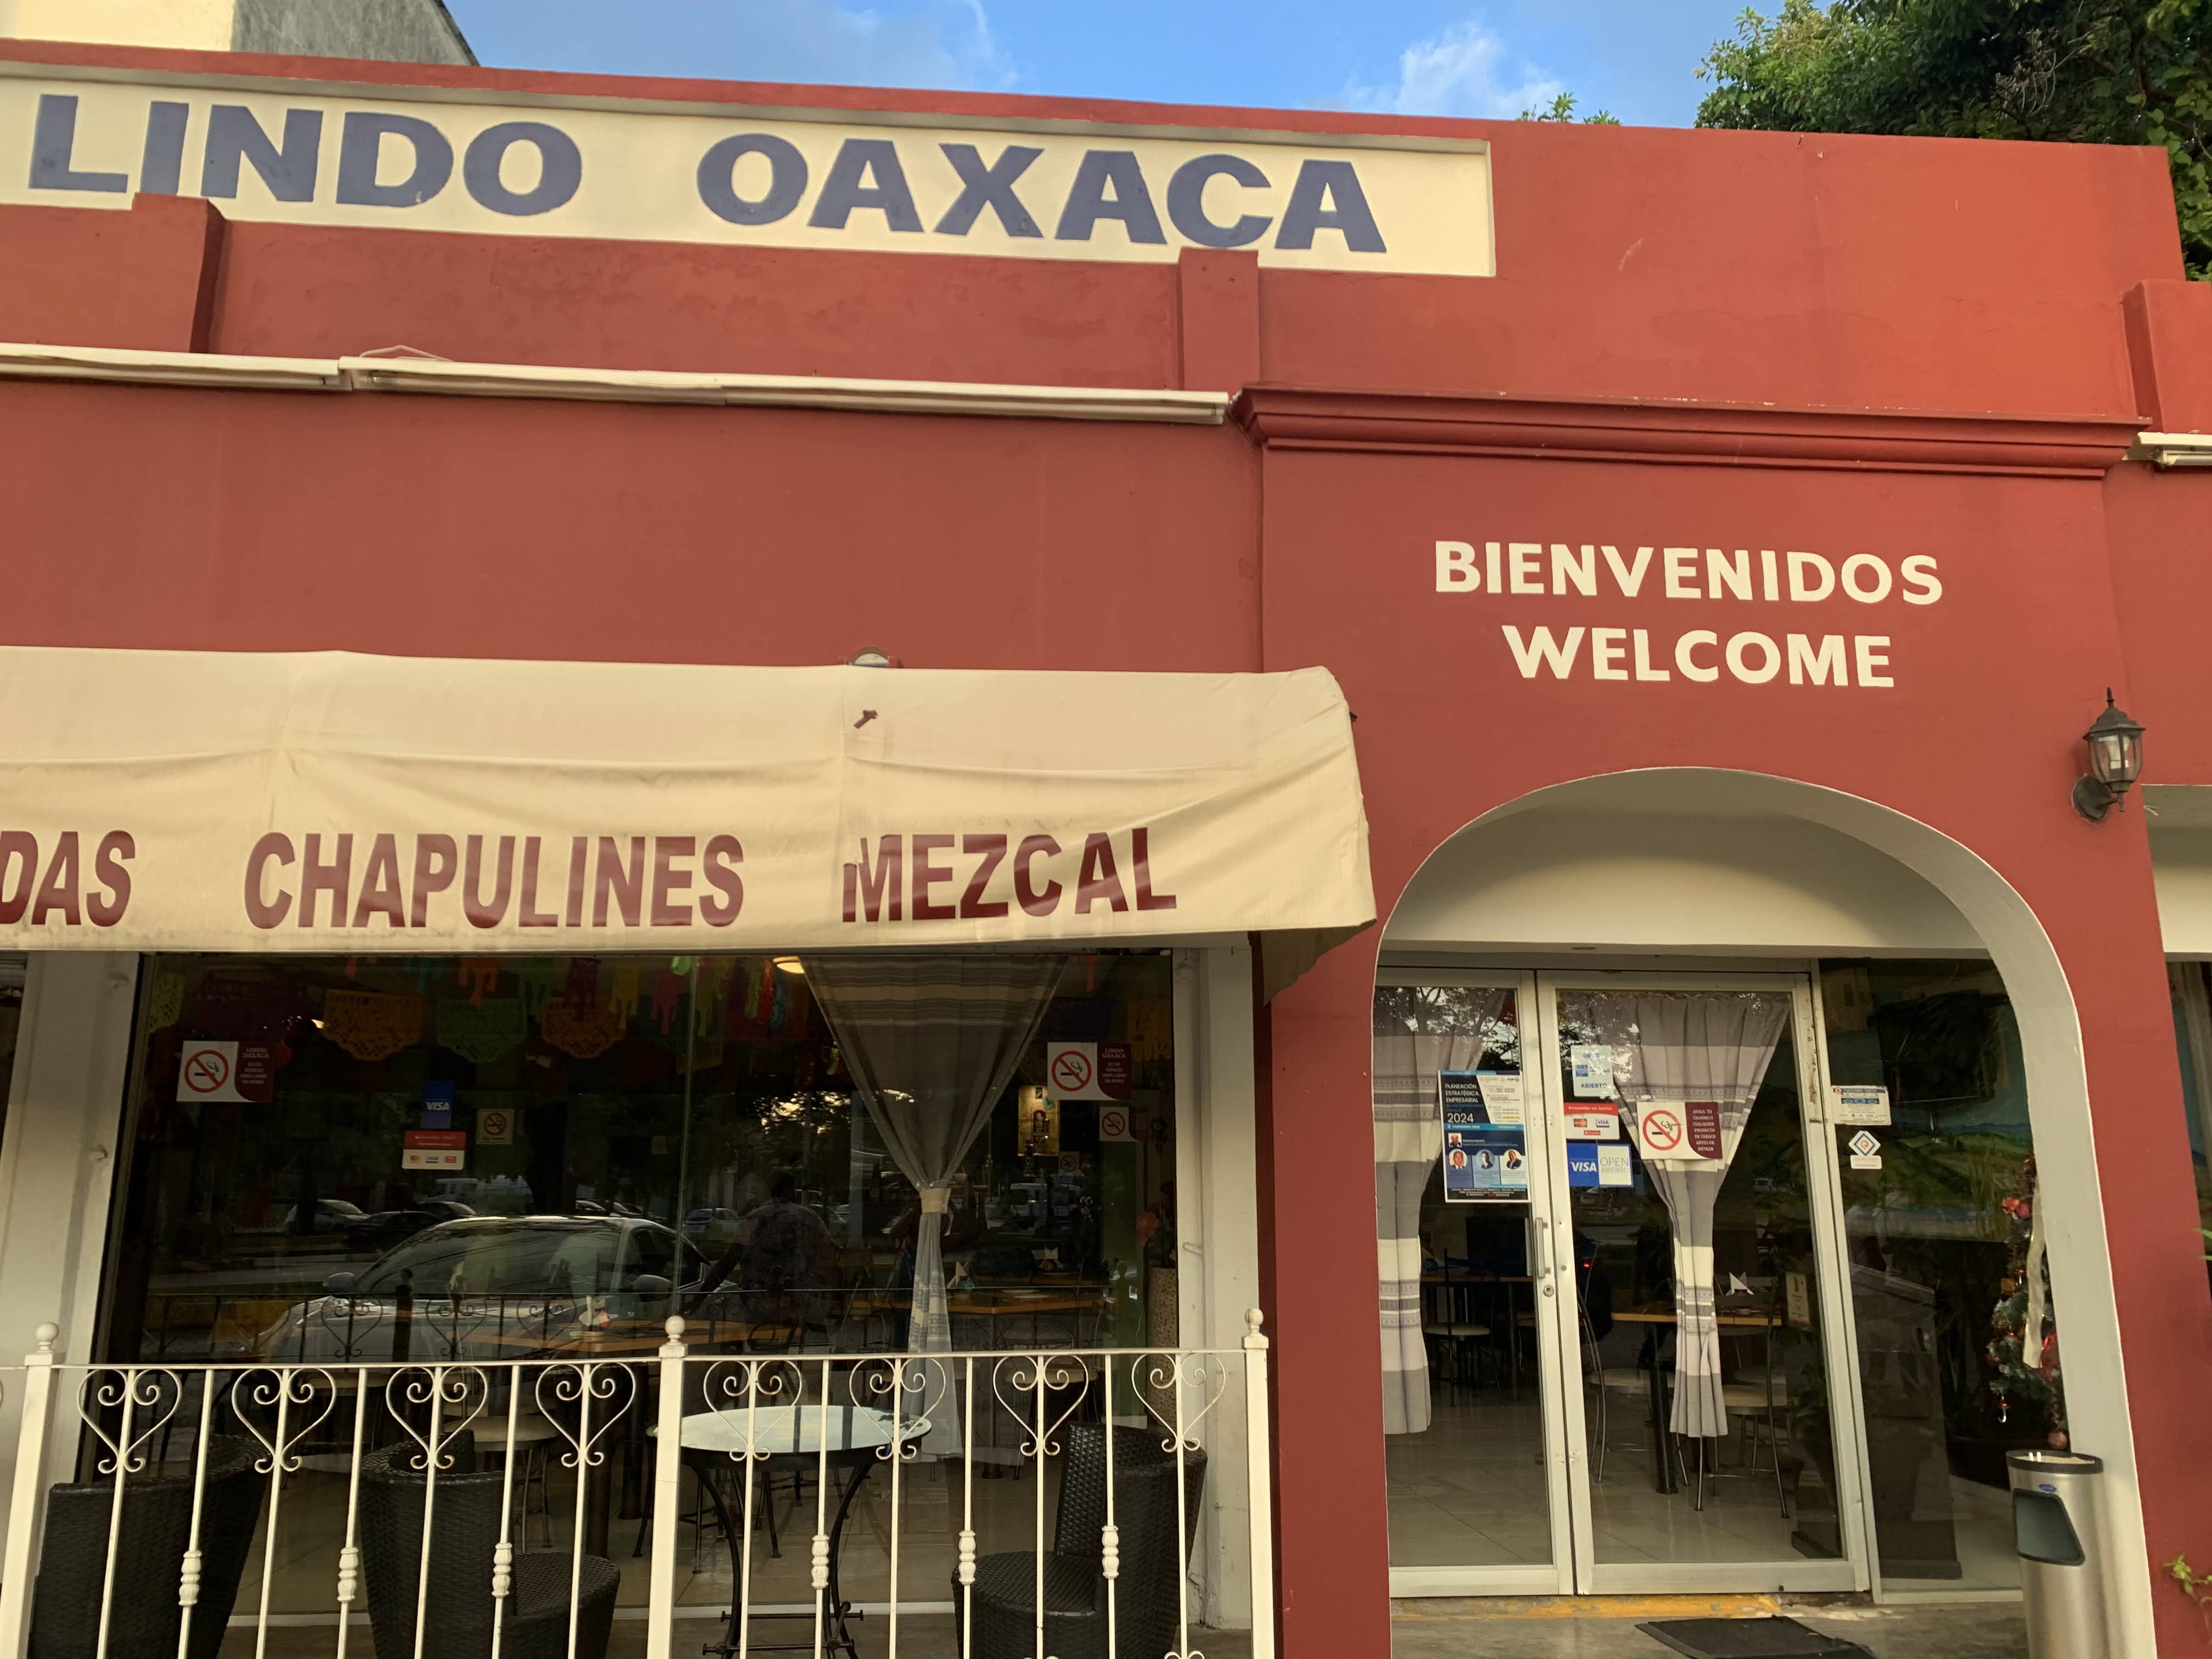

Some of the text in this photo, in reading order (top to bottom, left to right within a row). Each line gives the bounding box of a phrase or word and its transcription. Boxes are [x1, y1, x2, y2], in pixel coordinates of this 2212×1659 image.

[30, 94, 1387, 253] LINDO OAXACA
[1435, 540, 1944, 606] BIENVENIDOS
[1501, 625, 1895, 689] WELCOME
[244, 832, 744, 929] CHAPULINES
[842, 827, 1177, 923] MEZCAL
[426, 1102, 450, 1111] VISA
[1447, 1112, 1475, 1124] 2024
[1570, 1161, 1598, 1172] VISA
[1600, 1157, 1629, 1167] OPEN
